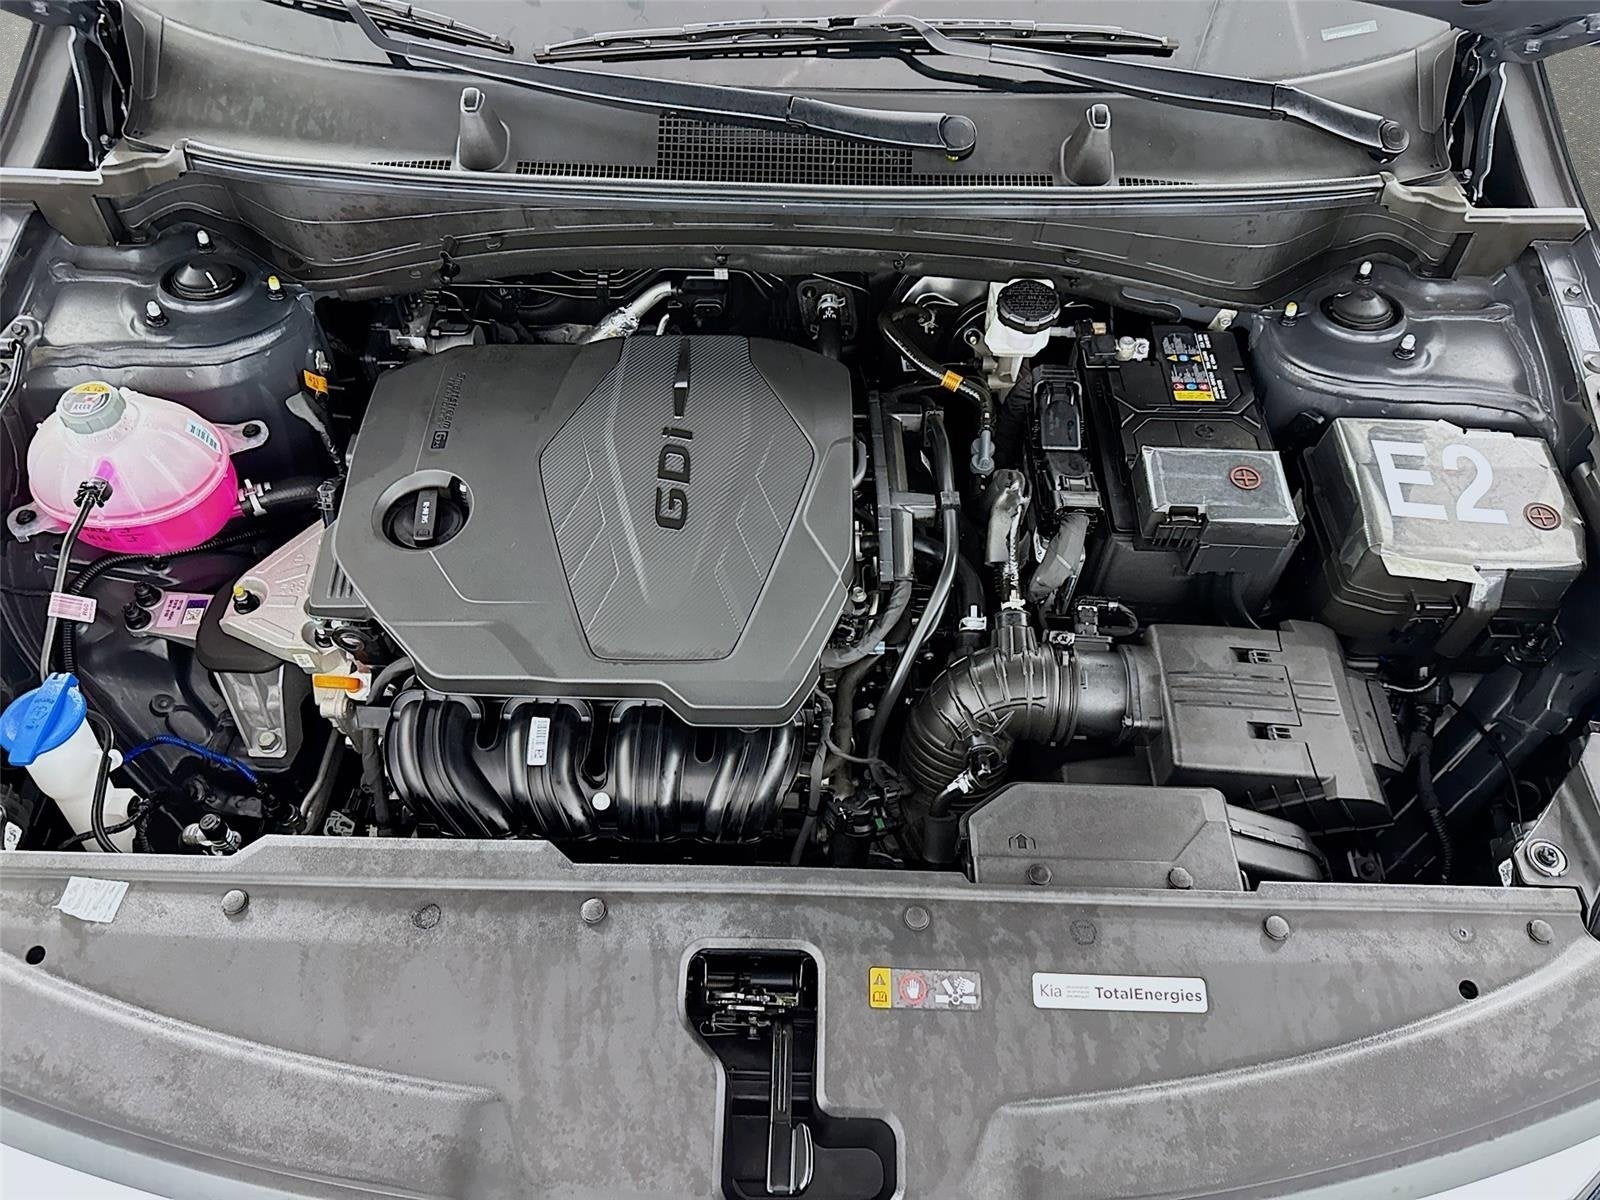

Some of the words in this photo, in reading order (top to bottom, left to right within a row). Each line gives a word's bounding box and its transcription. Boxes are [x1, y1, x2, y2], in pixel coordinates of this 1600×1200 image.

[655, 427, 693, 531] GDi
[1371, 440, 1509, 525] E2
[1040, 984, 1062, 998] Kia
[1095, 986, 1202, 1004] TotalEnergies
